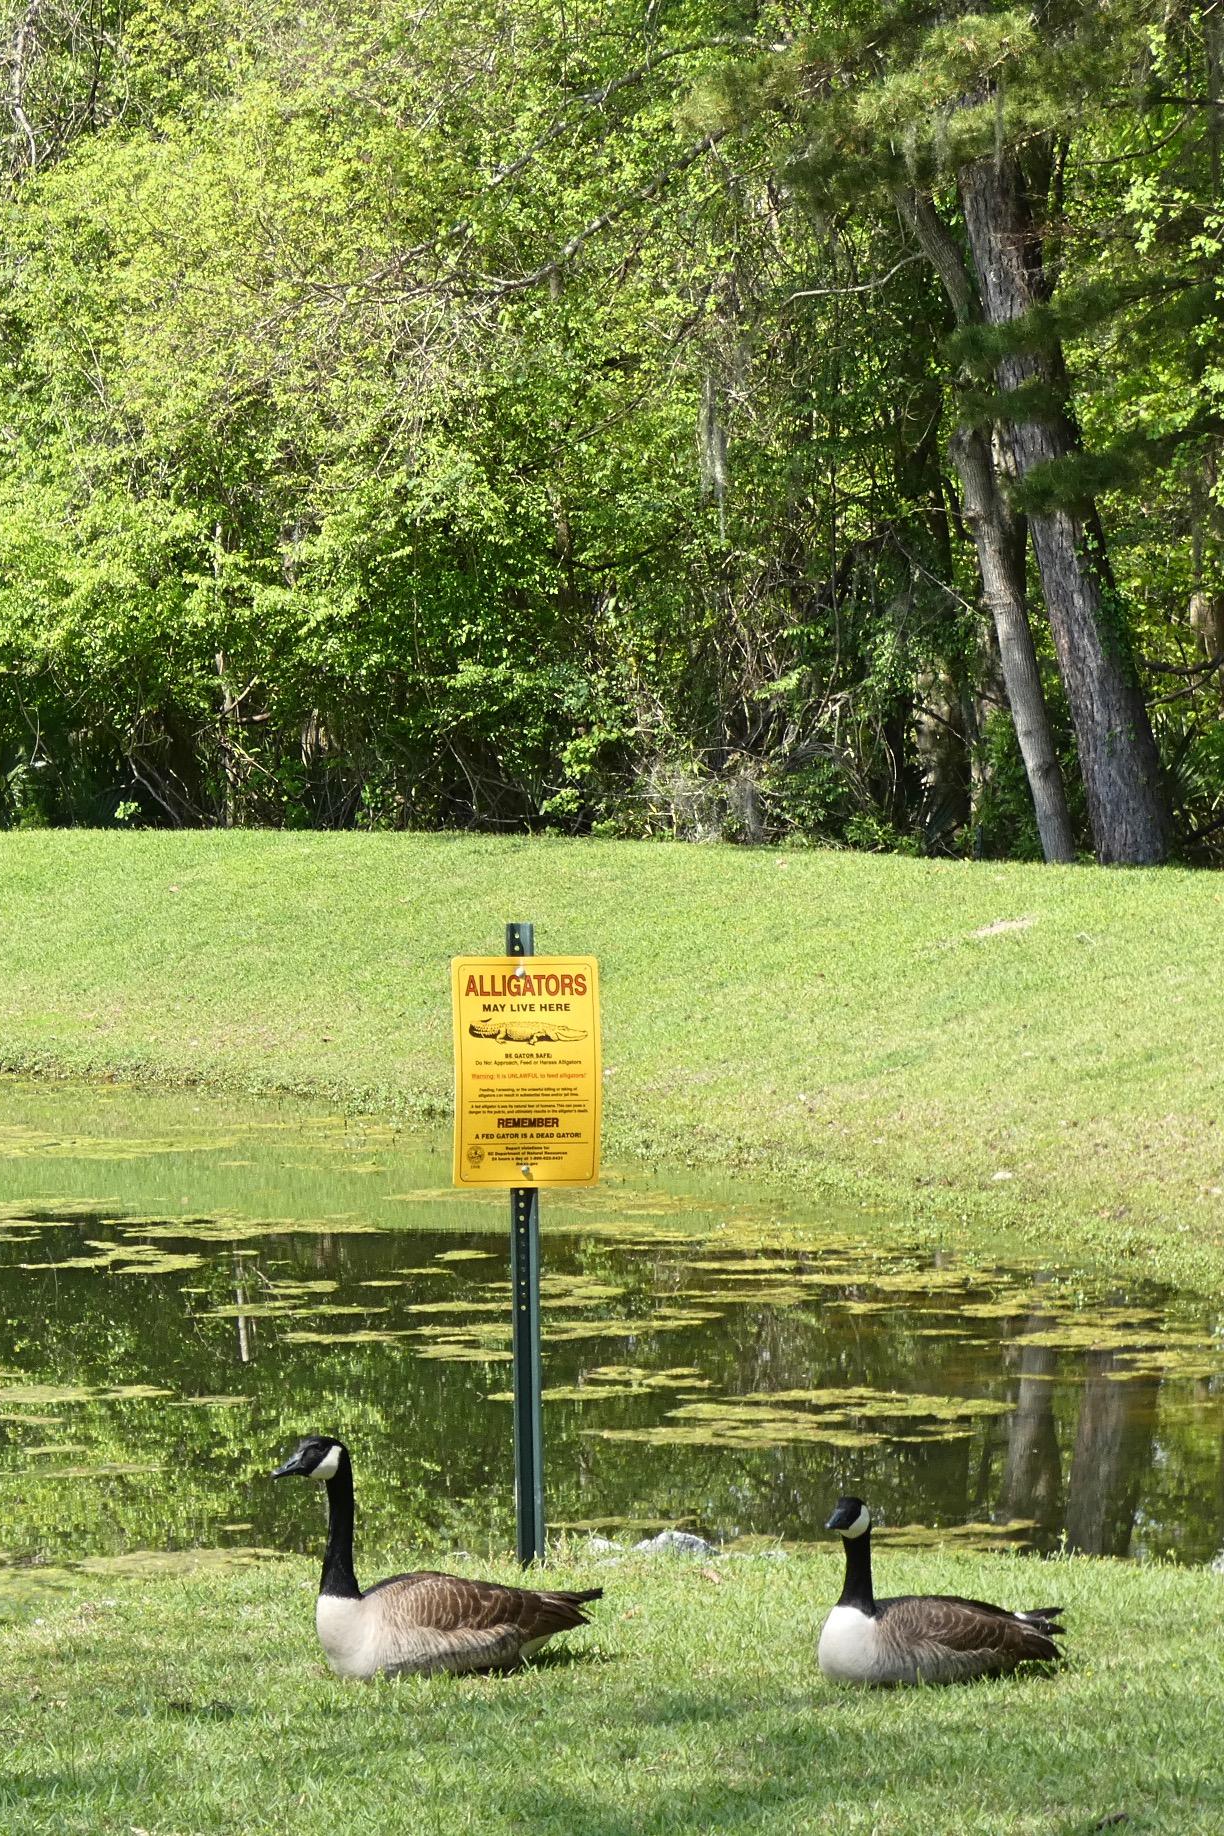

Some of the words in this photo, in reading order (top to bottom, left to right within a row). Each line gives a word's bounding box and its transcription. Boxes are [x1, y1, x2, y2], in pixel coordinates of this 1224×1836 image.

[465, 973, 588, 997] ALLIGATORS
[482, 1004, 506, 1012] MAY
[510, 1004, 535, 1012] LIVE
[540, 1004, 570, 1012] HERE
[497, 1117, 559, 1128] REMEMBER
